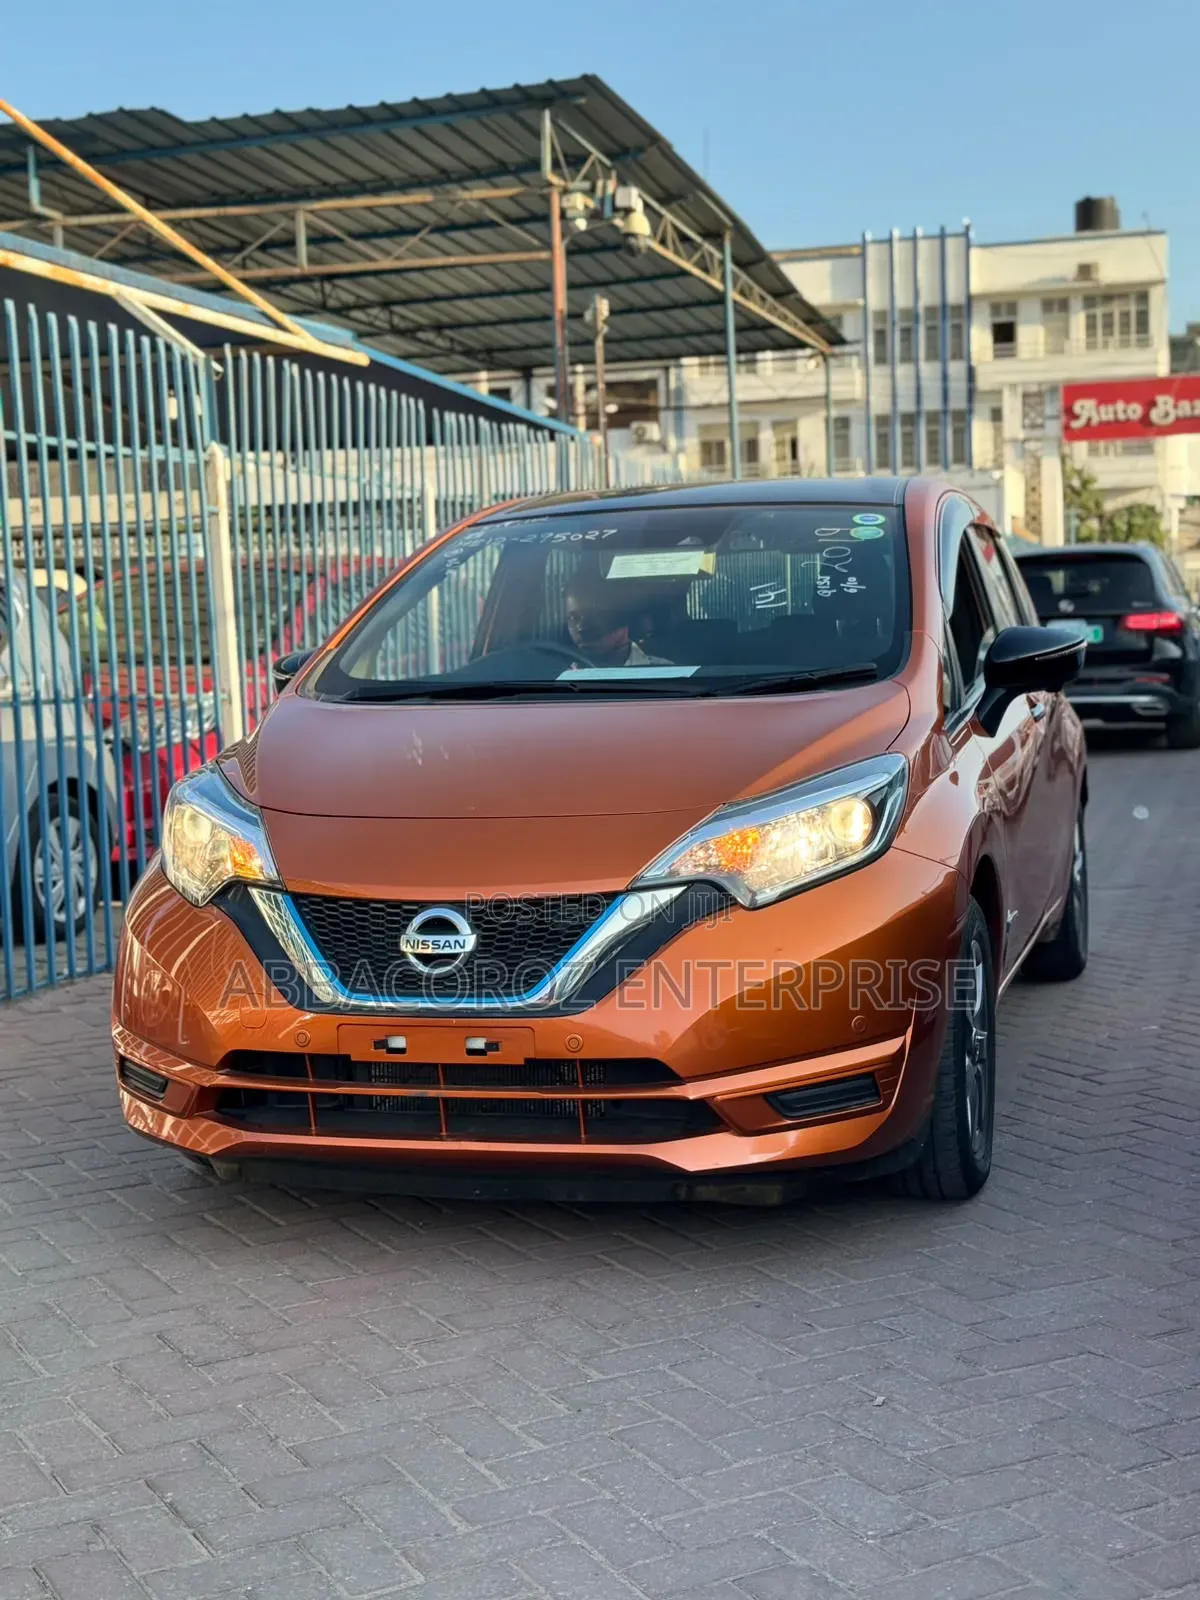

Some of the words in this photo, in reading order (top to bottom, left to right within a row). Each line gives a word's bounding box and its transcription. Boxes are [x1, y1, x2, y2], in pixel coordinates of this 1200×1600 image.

[1070, 398, 1143, 430] Auto
[801, 527, 866, 573] 2019
[404, 937, 467, 951] NISSAN
